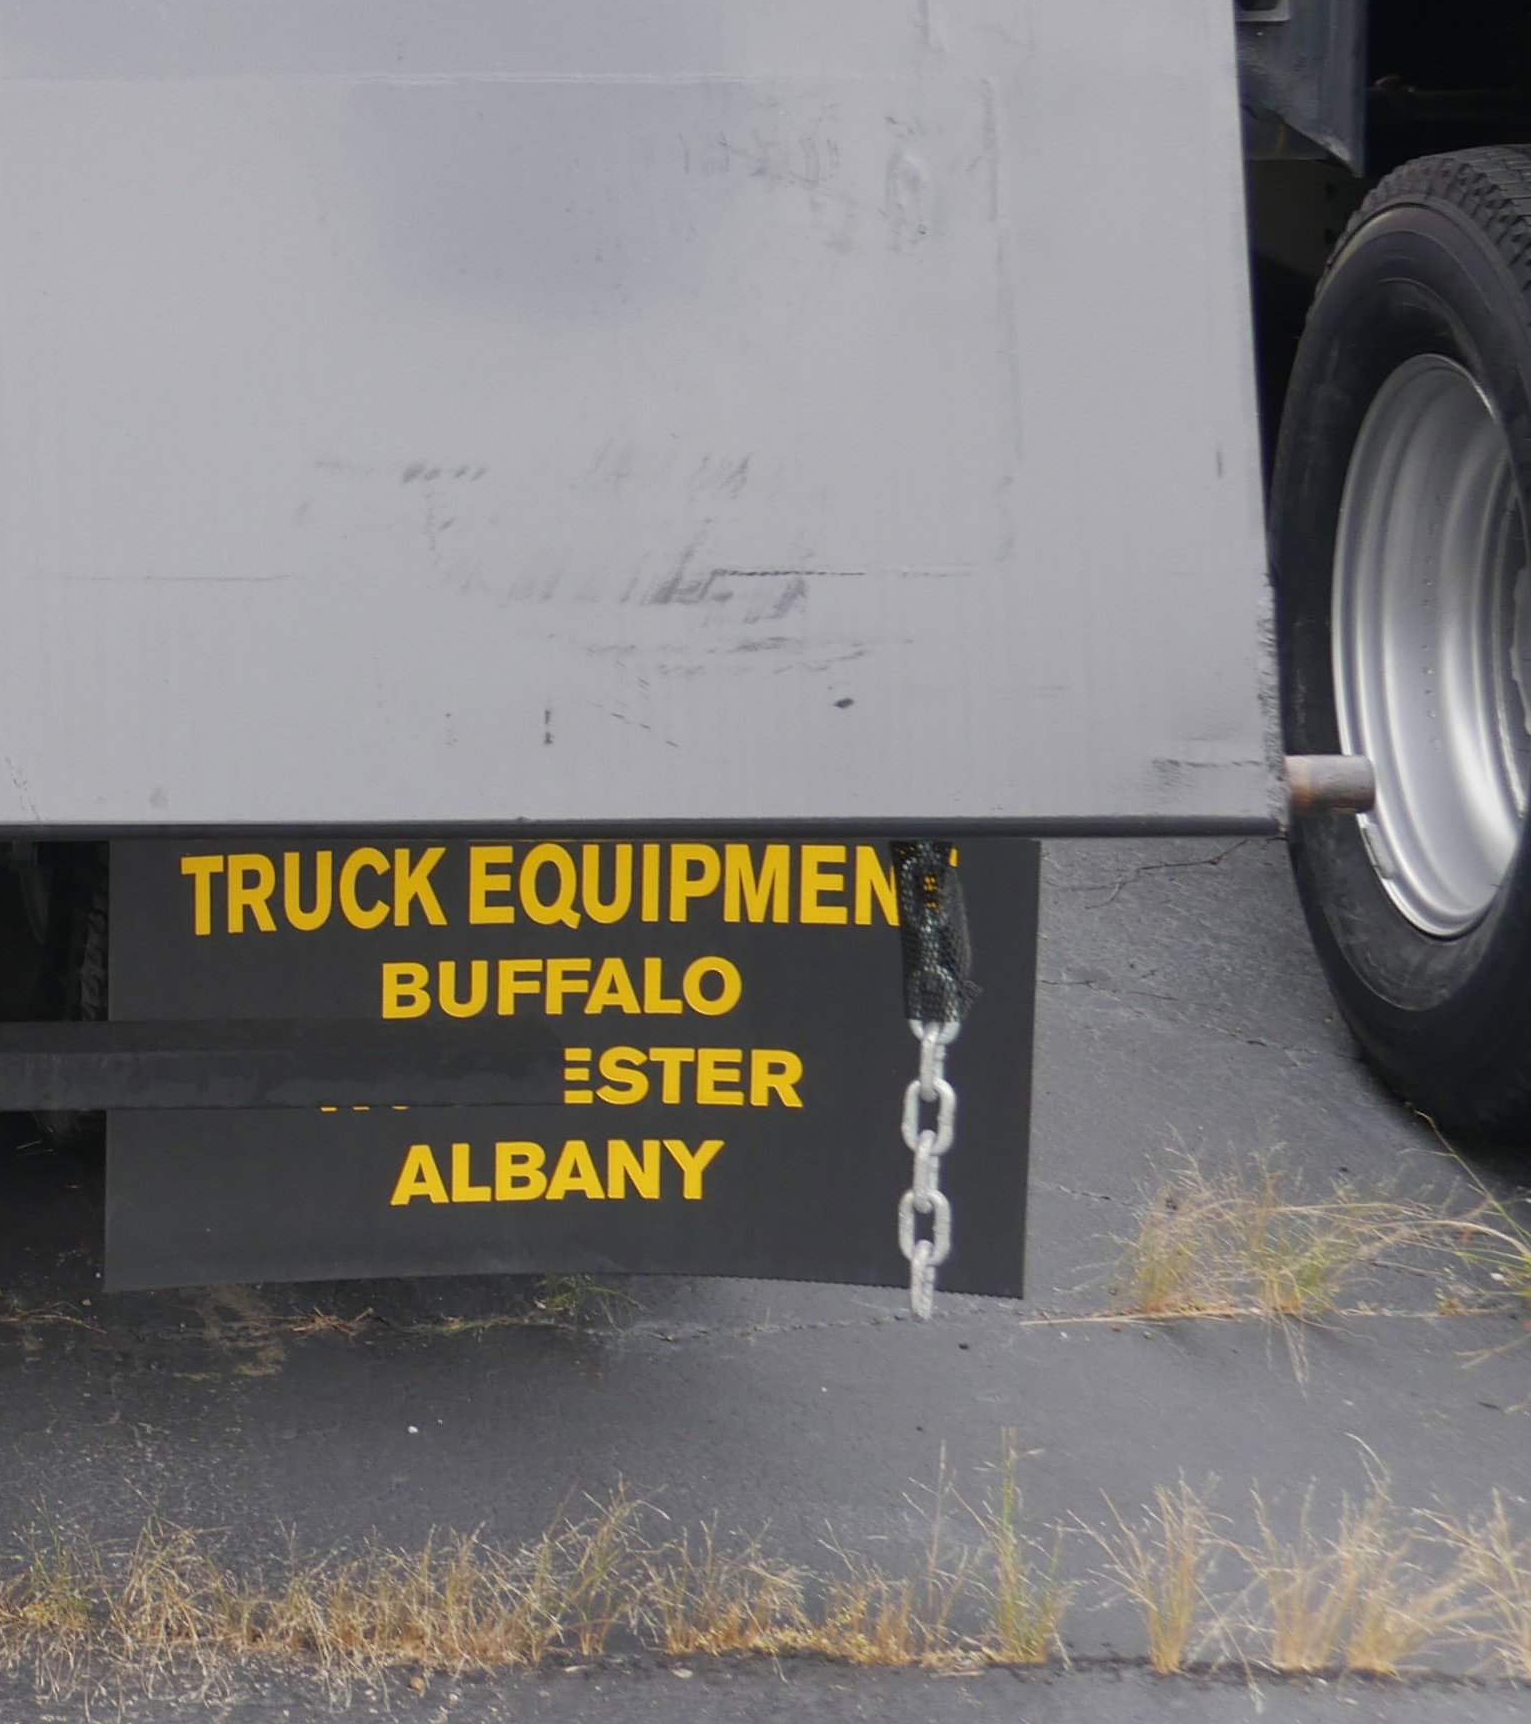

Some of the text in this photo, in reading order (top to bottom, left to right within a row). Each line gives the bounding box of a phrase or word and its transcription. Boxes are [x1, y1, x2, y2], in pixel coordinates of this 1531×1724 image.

[180, 842, 960, 936] TRUCK EQUIPMEN
[381, 955, 743, 1020] BUFFALO
[562, 1044, 805, 1109] ESTER
[389, 1137, 726, 1207] ALBANY
